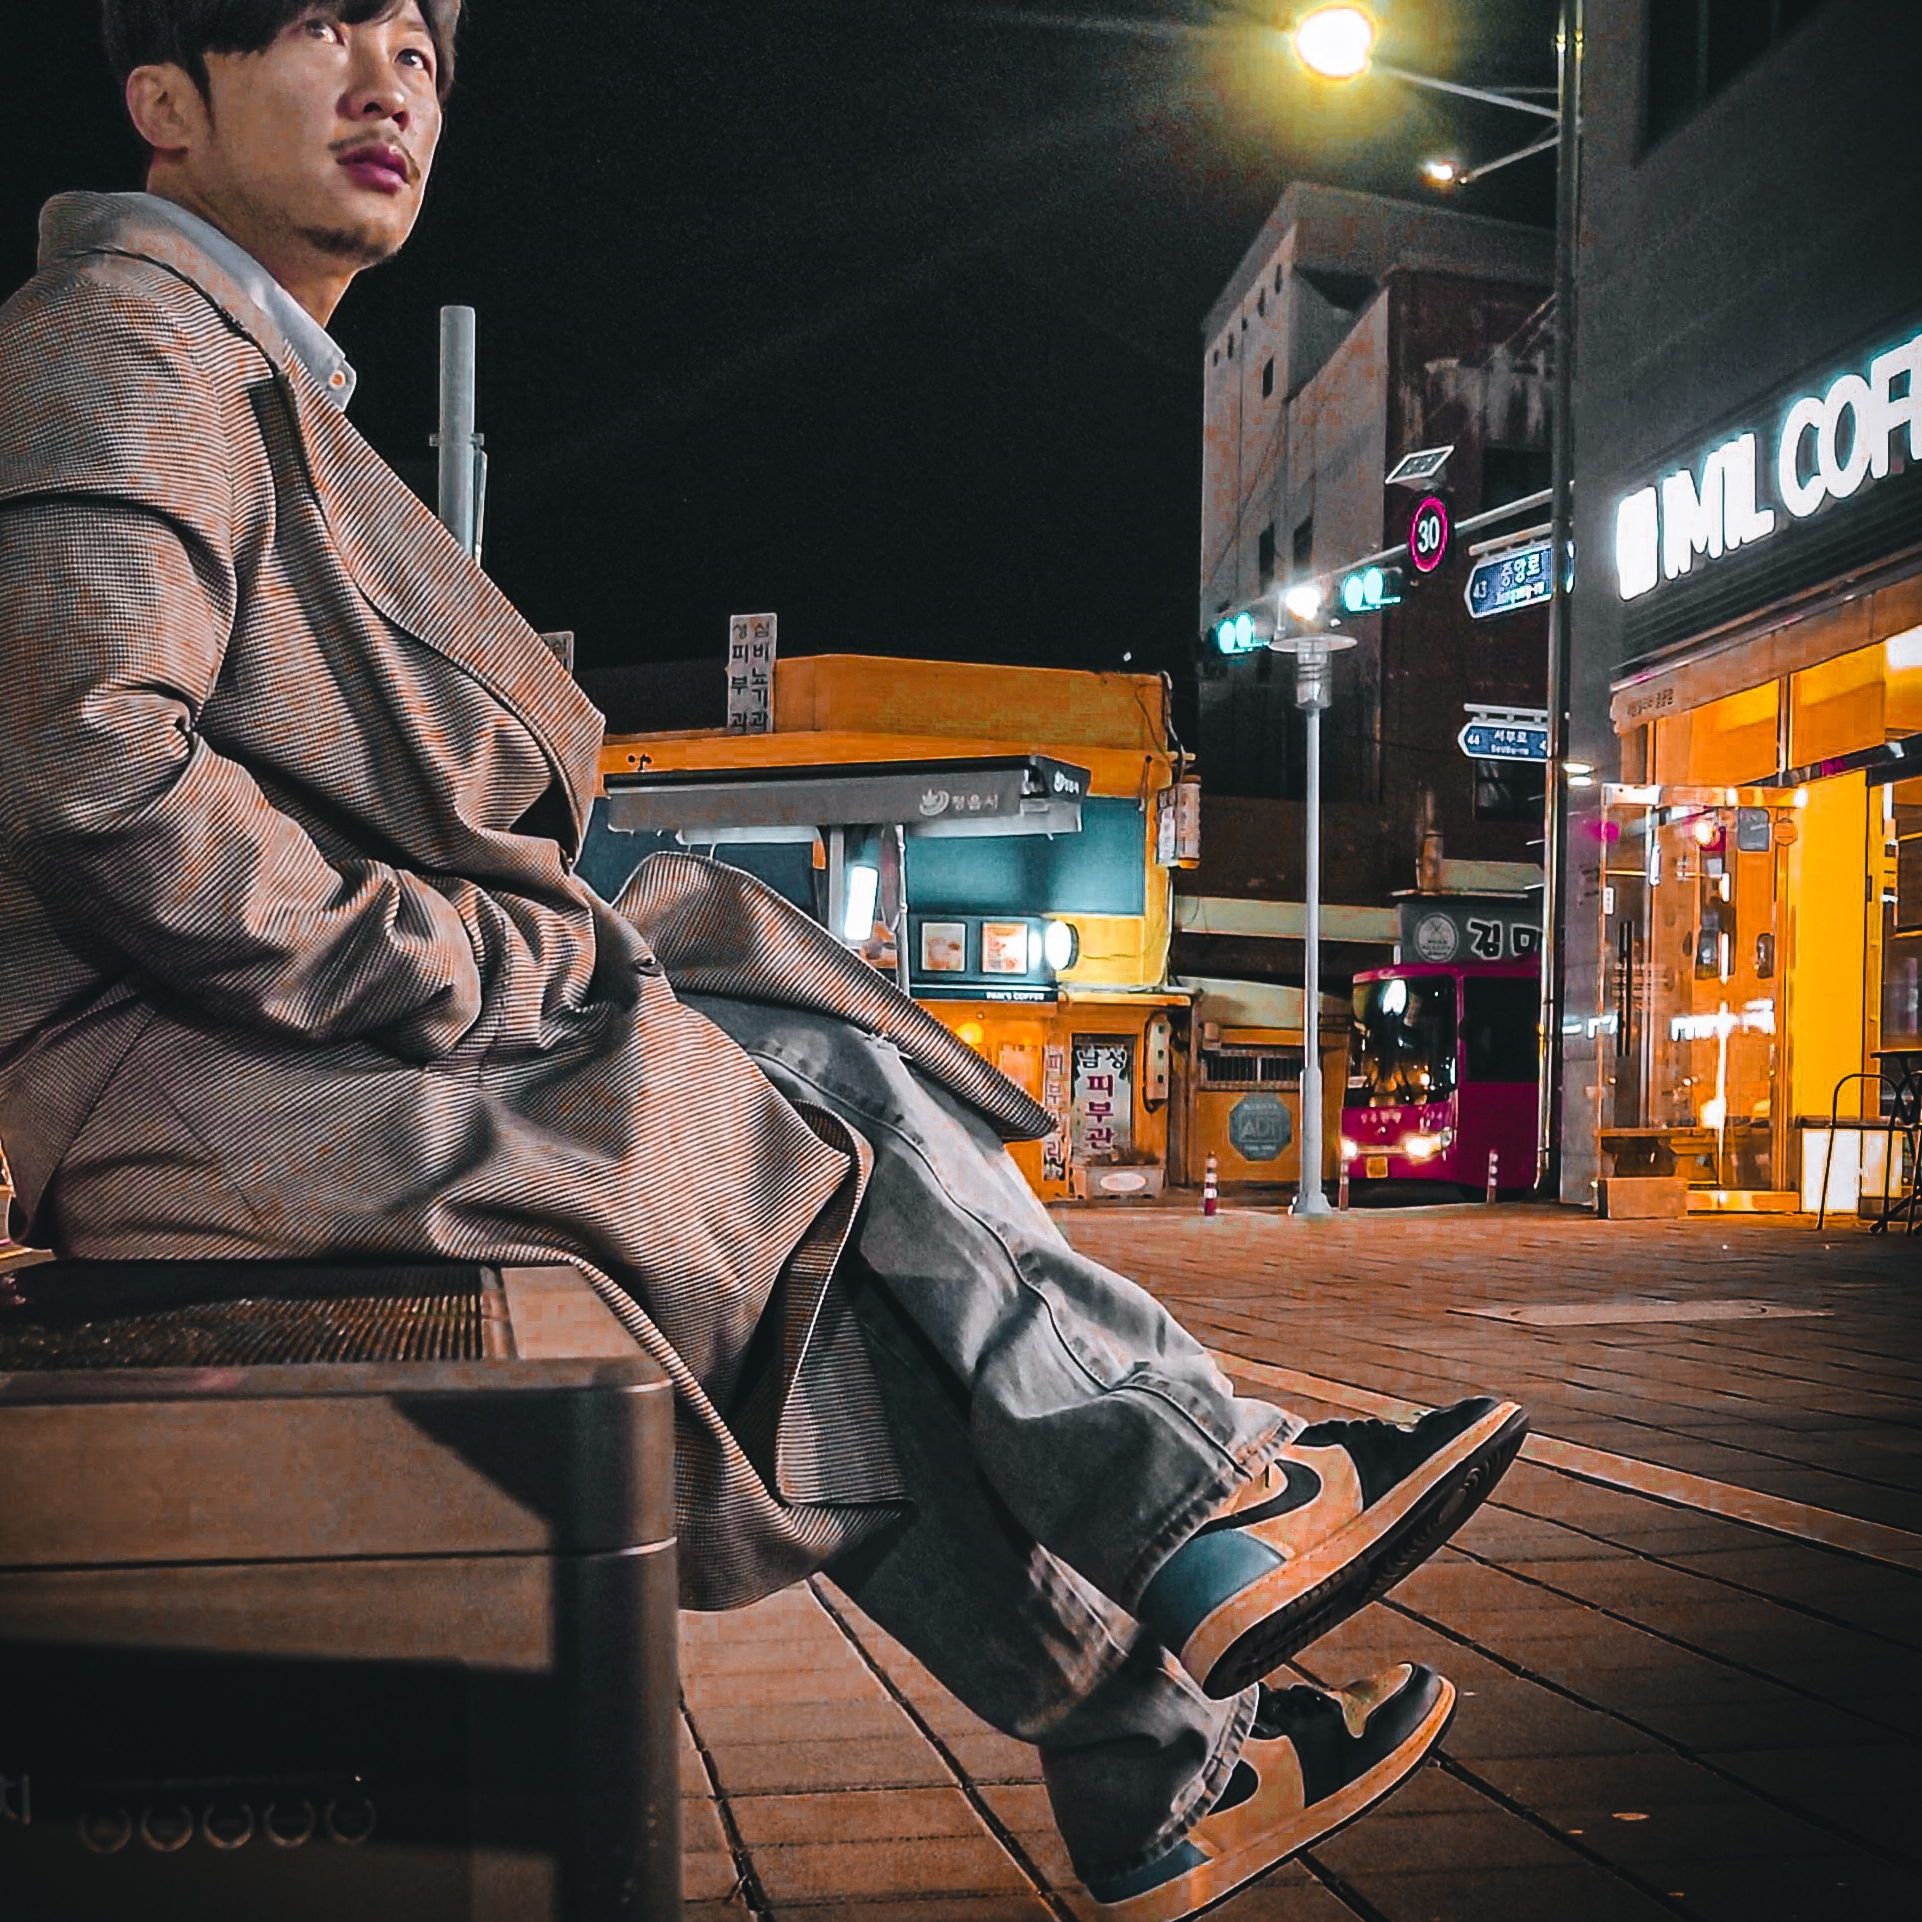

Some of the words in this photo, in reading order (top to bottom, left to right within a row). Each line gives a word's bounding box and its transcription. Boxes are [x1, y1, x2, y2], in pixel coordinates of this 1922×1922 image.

[1418, 516, 1440, 552] 30
[1473, 580, 1488, 598] 43
[1501, 554, 1540, 586] 중앙로
[1079, 1049, 1126, 1069] 남성
